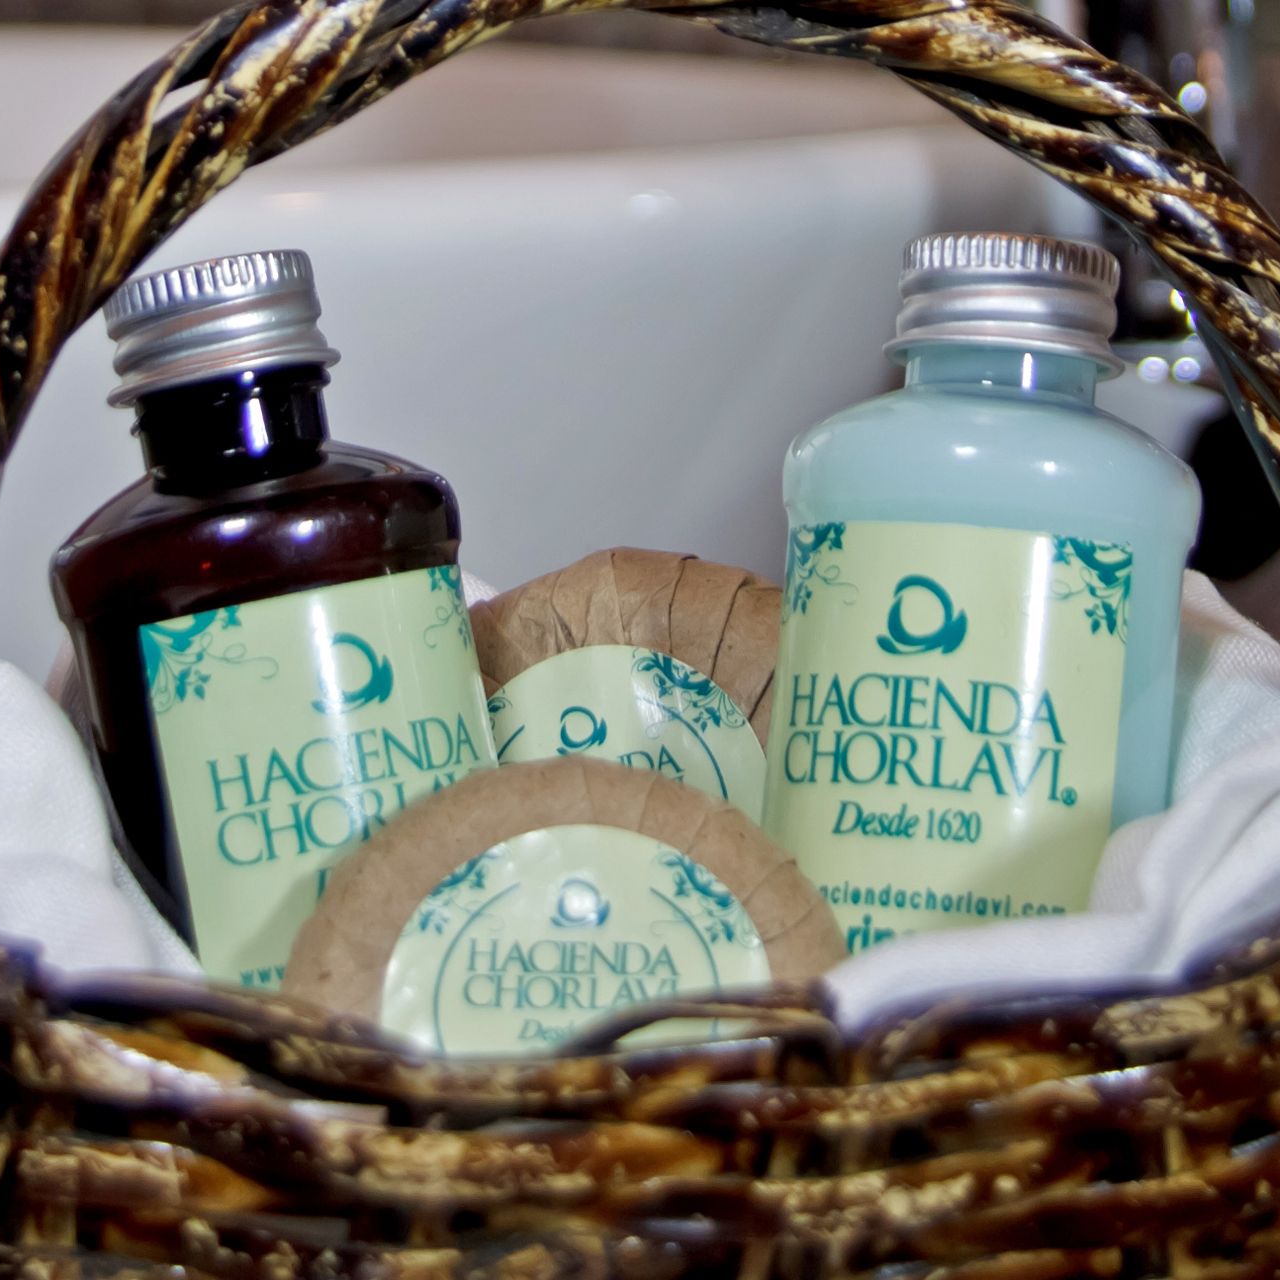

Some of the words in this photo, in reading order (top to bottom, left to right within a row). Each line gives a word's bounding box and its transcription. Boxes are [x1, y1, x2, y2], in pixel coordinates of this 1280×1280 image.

[789, 673, 1067, 744] HACIENDA
[206, 712, 480, 812] HACENDA
[832, 800, 919, 839] Desde
[925, 808, 983, 843] 1620
[465, 937, 680, 977] HACIENDA
